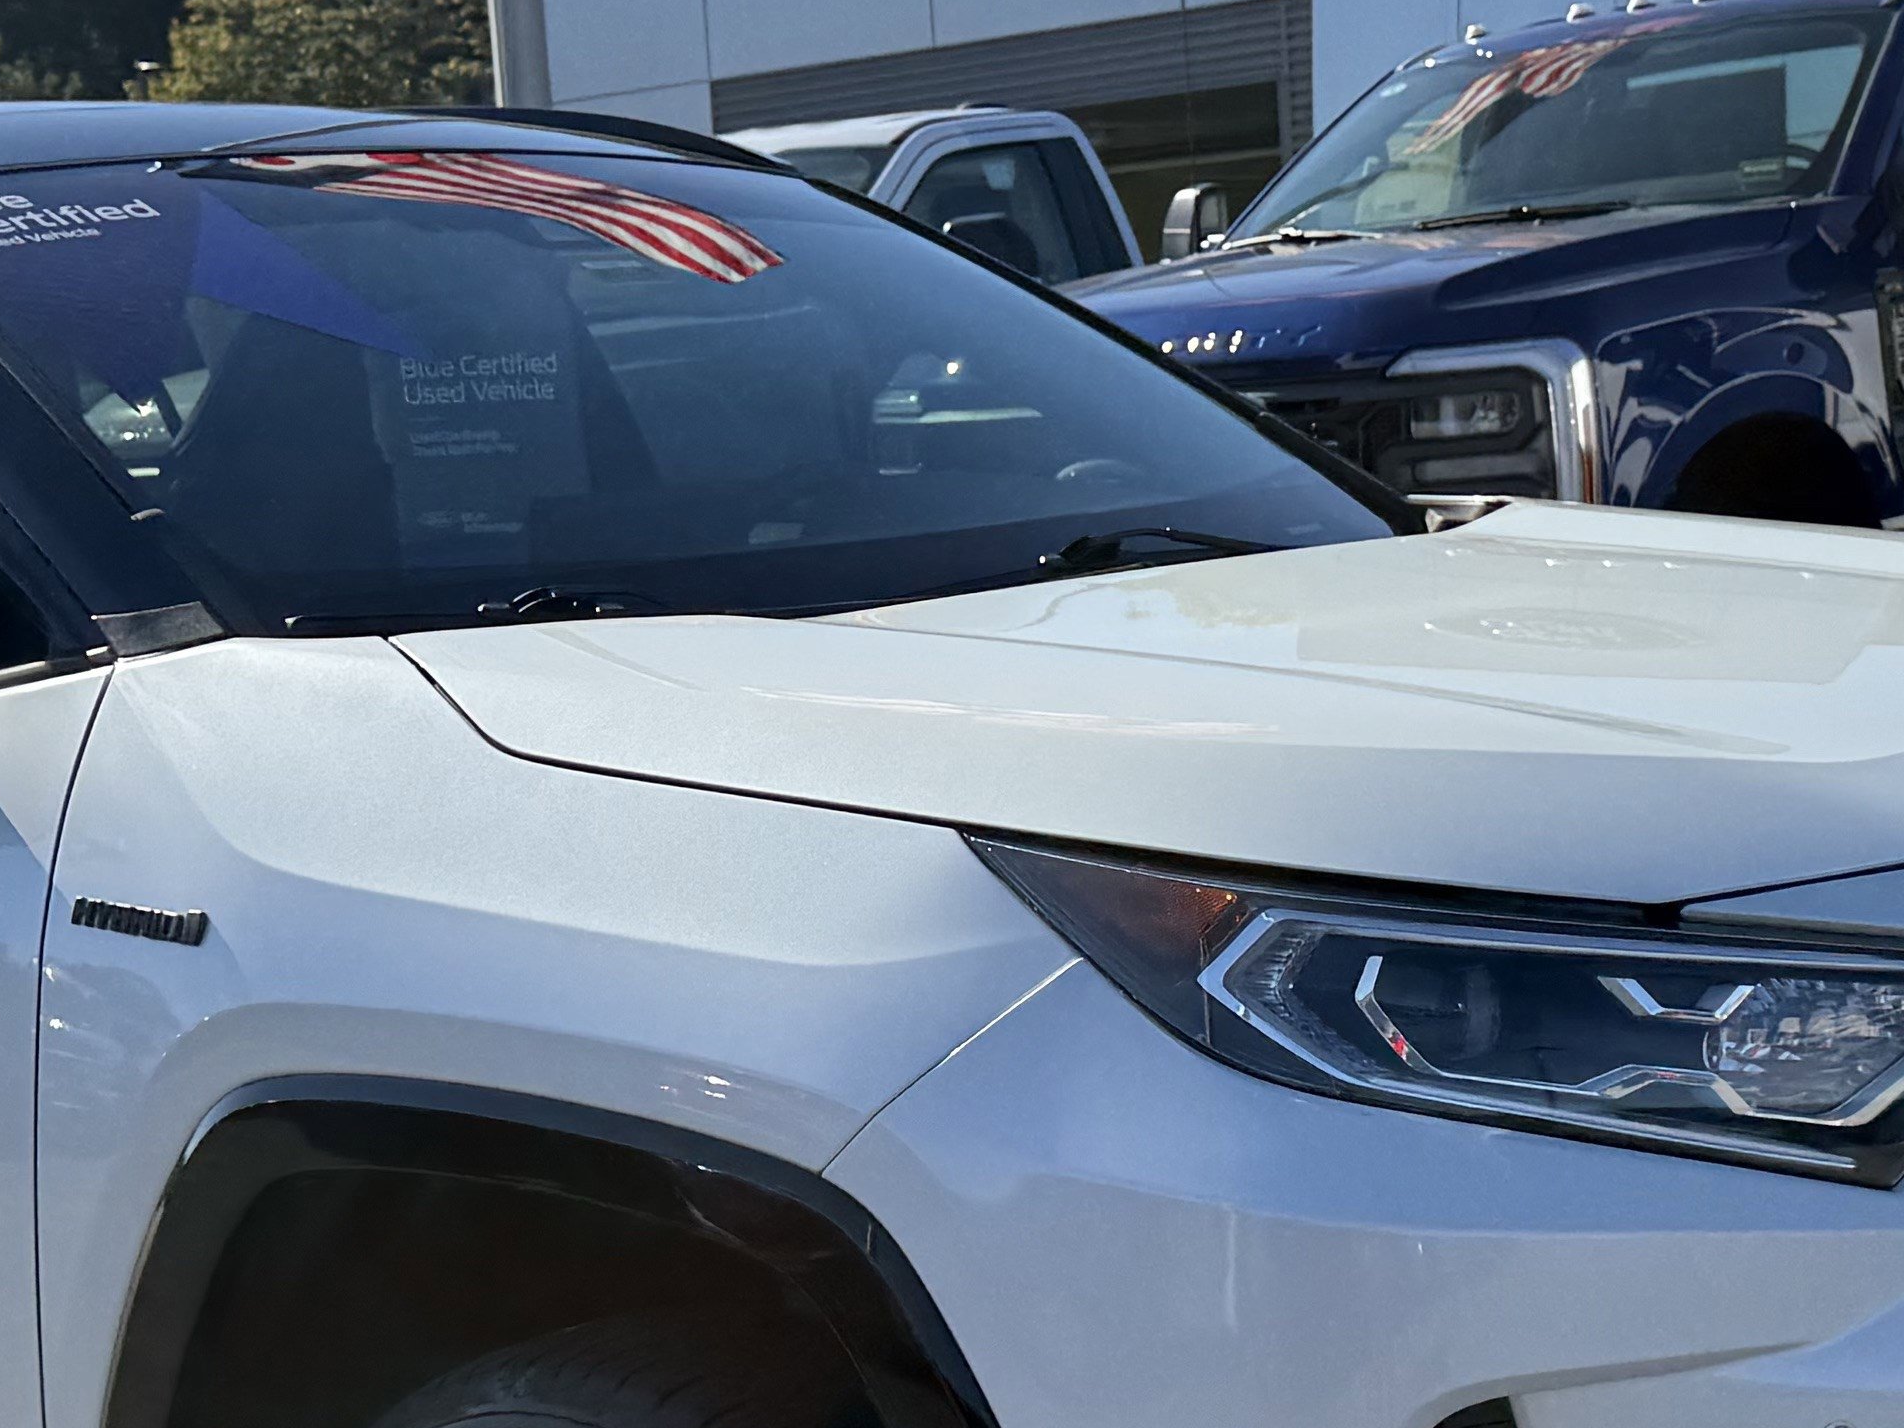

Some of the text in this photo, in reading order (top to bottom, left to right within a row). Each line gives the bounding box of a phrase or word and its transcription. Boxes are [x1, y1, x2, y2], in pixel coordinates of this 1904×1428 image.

[399, 355, 455, 380] Blue
[403, 375, 556, 405] Used Vehicle
